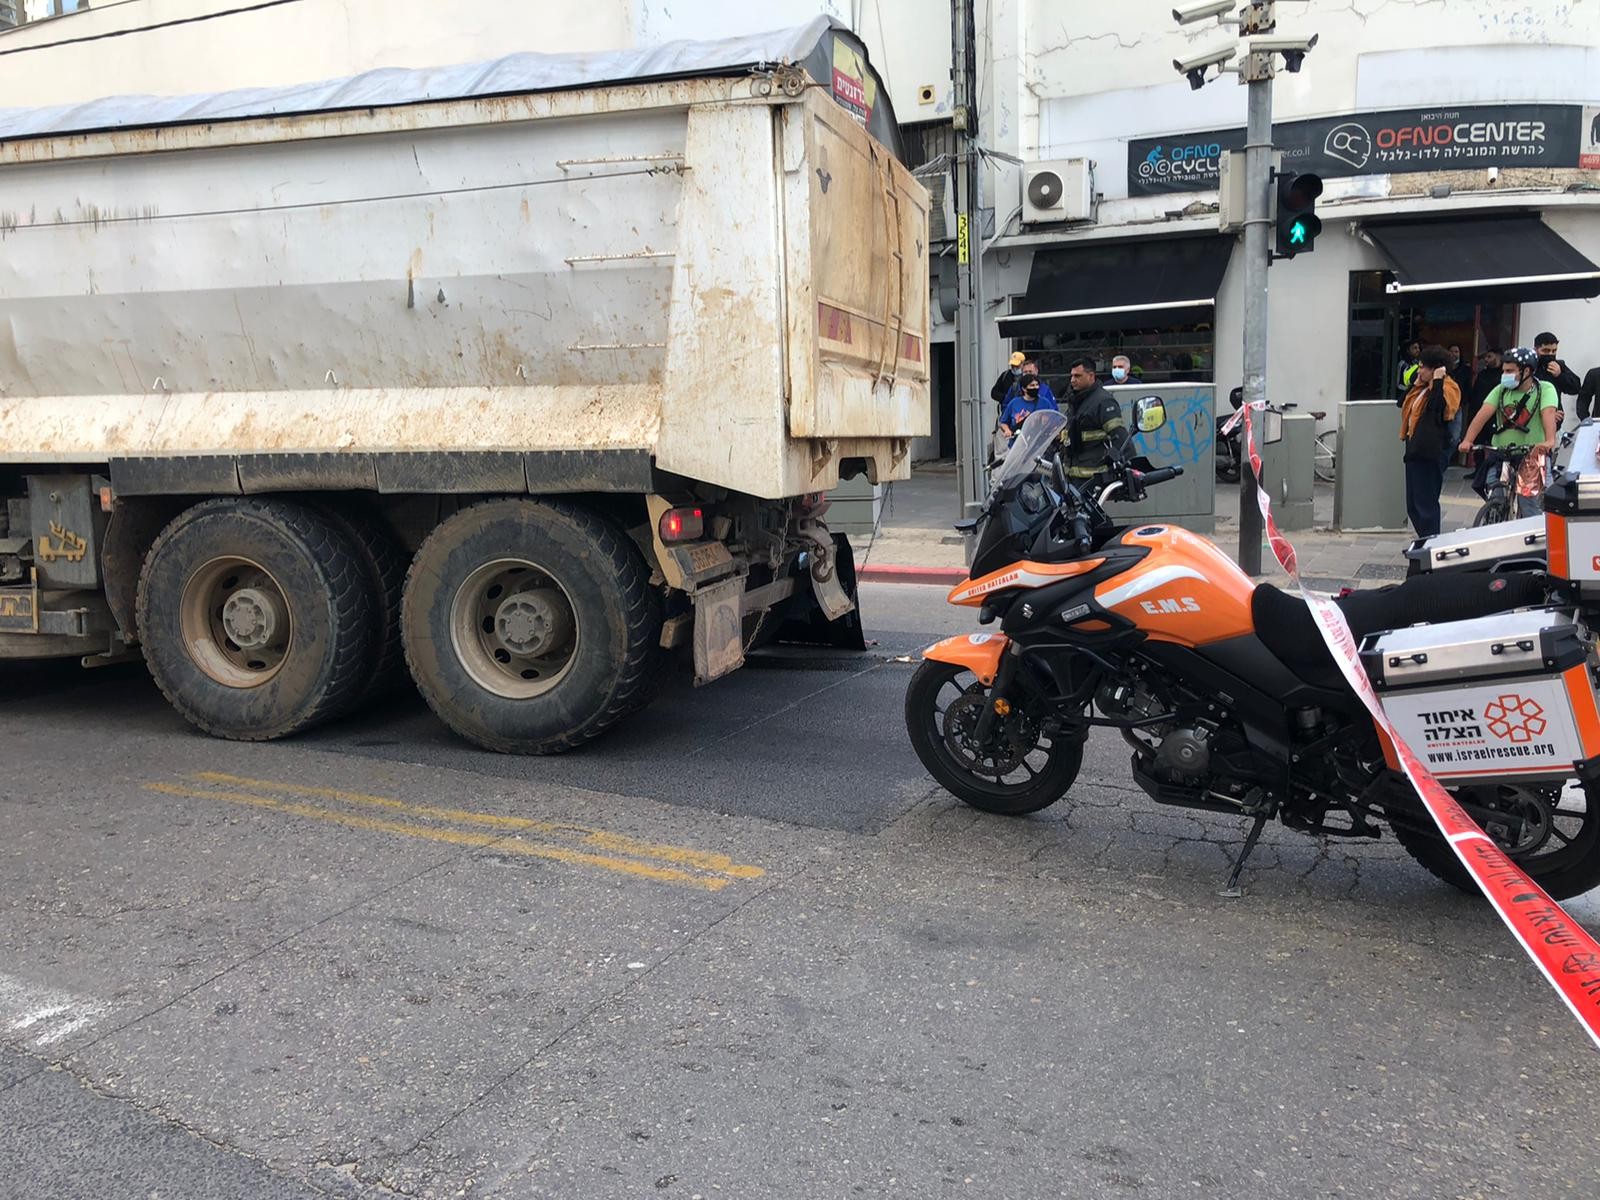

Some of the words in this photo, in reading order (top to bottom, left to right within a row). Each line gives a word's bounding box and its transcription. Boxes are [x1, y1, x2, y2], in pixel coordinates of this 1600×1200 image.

[1444, 111, 1460, 120] חנות
[1376, 121, 1546, 149] OFNOCENTER
[1171, 143, 1220, 161] OFNO
[1375, 147, 1440, 162] לדו-גלגלי
[1444, 145, 1497, 159] המובילה
[1502, 145, 1536, 156] הרשת
[1171, 158, 1221, 175] CYCL
[959, 216, 968, 263] 3541
[1417, 708, 1477, 725] איחוד
[1424, 725, 1482, 741] הצלה
[1427, 743, 1555, 764] www.israelrescue.org
